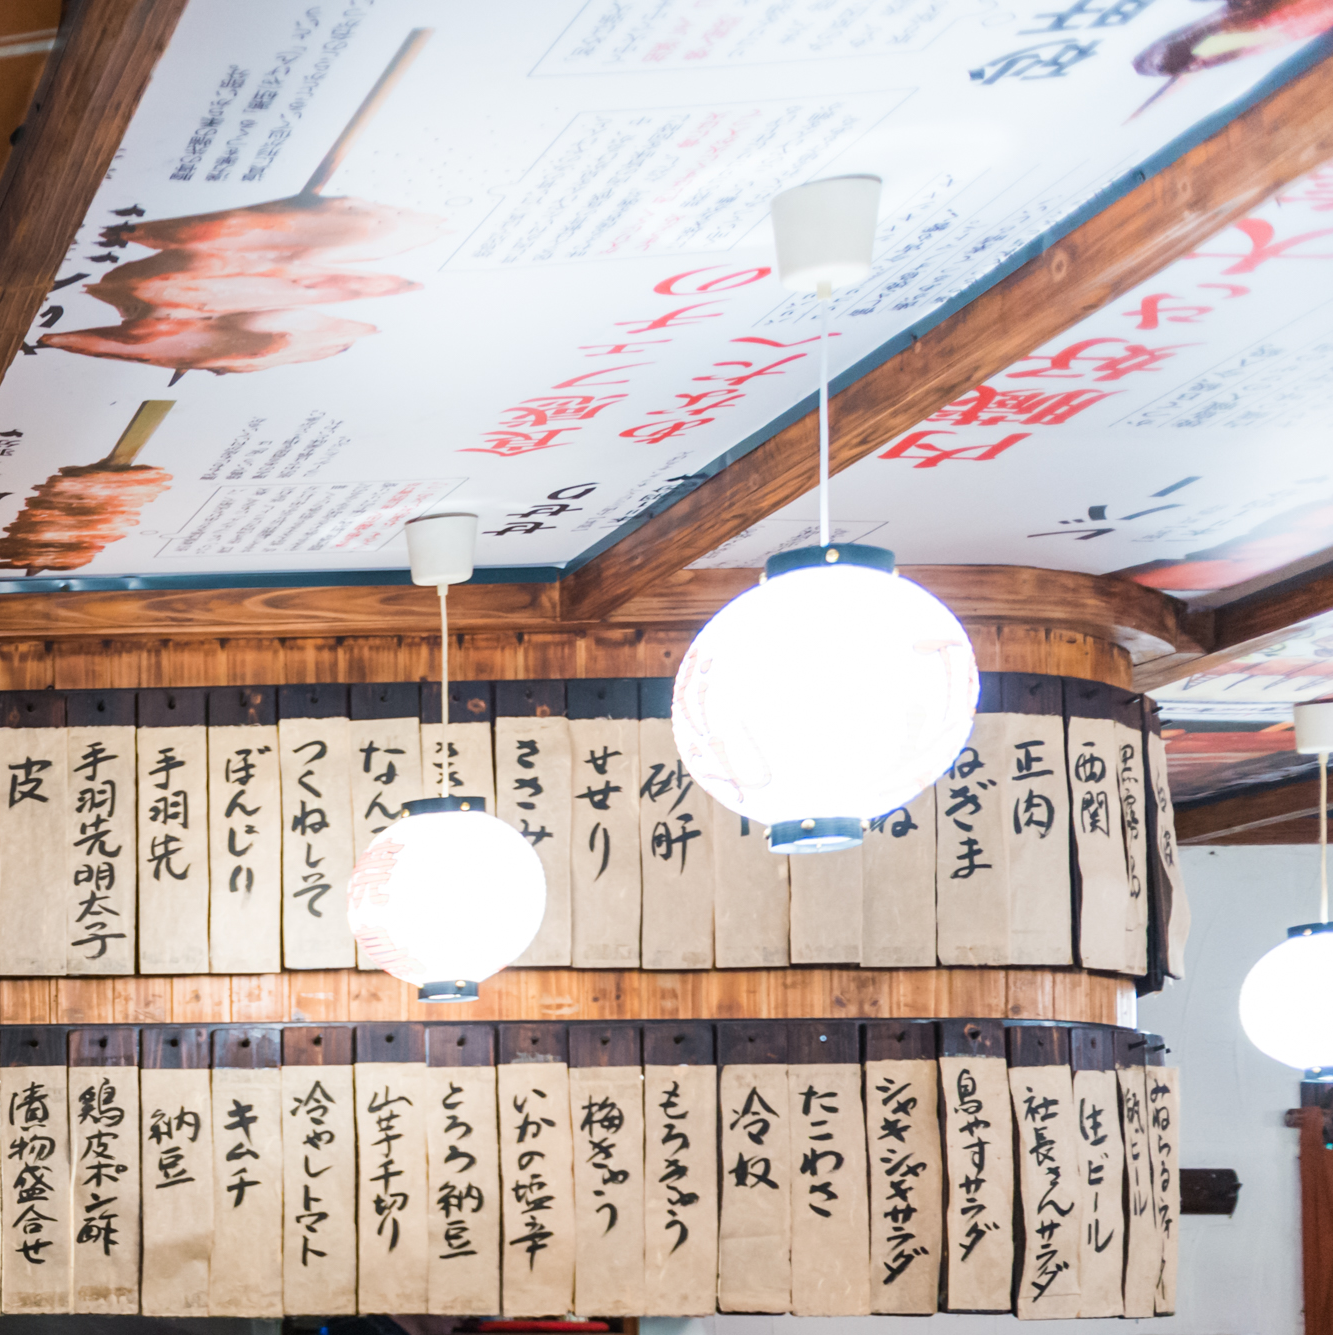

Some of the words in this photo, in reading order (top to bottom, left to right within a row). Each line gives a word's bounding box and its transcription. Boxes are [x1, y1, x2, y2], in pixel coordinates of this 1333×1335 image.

[453, 264, 771, 457] 食感フェチの
[619, 332, 842, 444] あなたへ
[483, 482, 601, 536] せせり
[1026, 476, 1201, 540] レバー
[9, 757, 52, 808] 皮
[147, 748, 189, 880] 手羽先
[225, 746, 271, 892] ぼんじり
[576, 746, 622, 877] せせり
[1012, 741, 1054, 838] 正肉
[72, 742, 126, 959] 手羽先明太子
[8, 1082, 57, 1264] 漬物盛合せ
[149, 1106, 200, 1189] 納豆
[225, 1100, 260, 1207] キムチ
[291, 1081, 334, 1266] 冷やしトマト
[510, 1089, 555, 1270] いかの塩辛
[728, 1087, 779, 1189] 冷奴
[799, 1085, 844, 1217] たこわさ
[876, 1078, 929, 1285] シャキシャキサラダ
[1024, 1087, 1074, 1302] 社長さんサラダ
[1080, 1098, 1113, 1252] 生ビール
